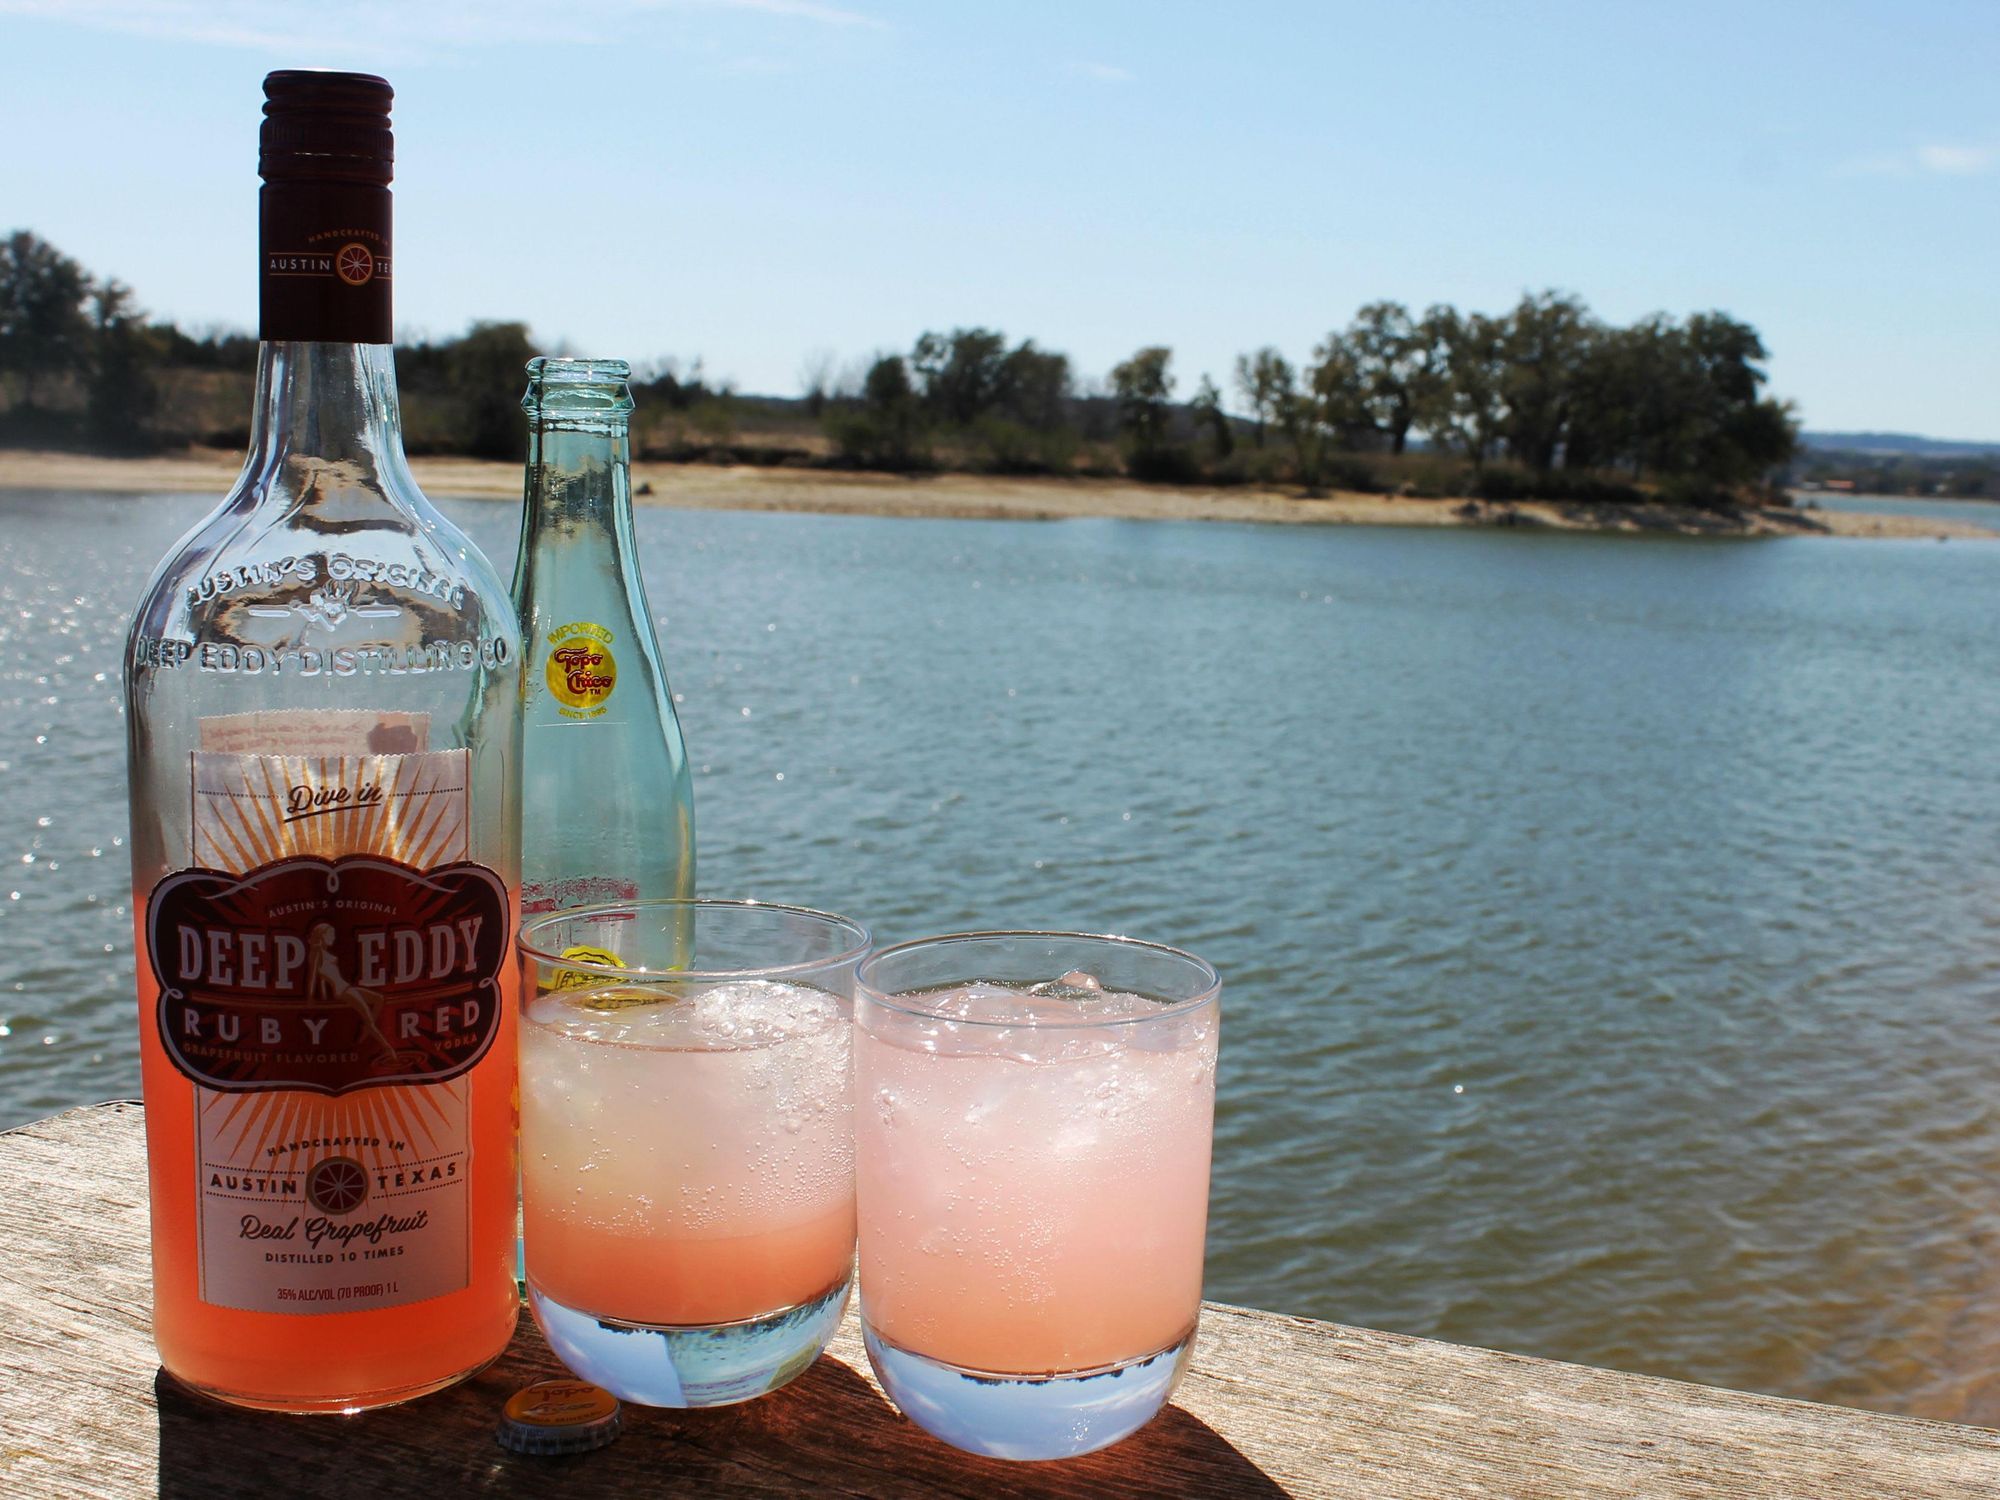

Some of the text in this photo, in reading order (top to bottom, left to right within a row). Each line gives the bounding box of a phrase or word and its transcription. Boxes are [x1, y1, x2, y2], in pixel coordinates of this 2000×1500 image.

[270, 259, 330, 270] AUSTIN
[547, 622, 614, 644] IMPORTED
[199, 641, 289, 676] EDDY
[554, 647, 603, 673] Topo
[567, 670, 613, 694] Chico
[286, 782, 382, 814] Dive in
[268, 899, 398, 918] AUSTIN'S ORIGINAL
[177, 916, 484, 989] DEEP EDDY
[184, 1000, 480, 1045] RUBY RED
[183, 1043, 359, 1064] GRAPEFRUIT FLAVORED
[433, 1033, 479, 1051] VODKA
[266, 1136, 405, 1158] HANDCRAFTED IN
[210, 1161, 457, 1195] AUSTIN TEXAS
[239, 1210, 429, 1250] Real Grapefruit
[265, 1246, 404, 1264] DISTILLED 10 TIMES
[277, 1282, 399, 1301] 35% ALC/VOL (70 PROOF) 1 L
